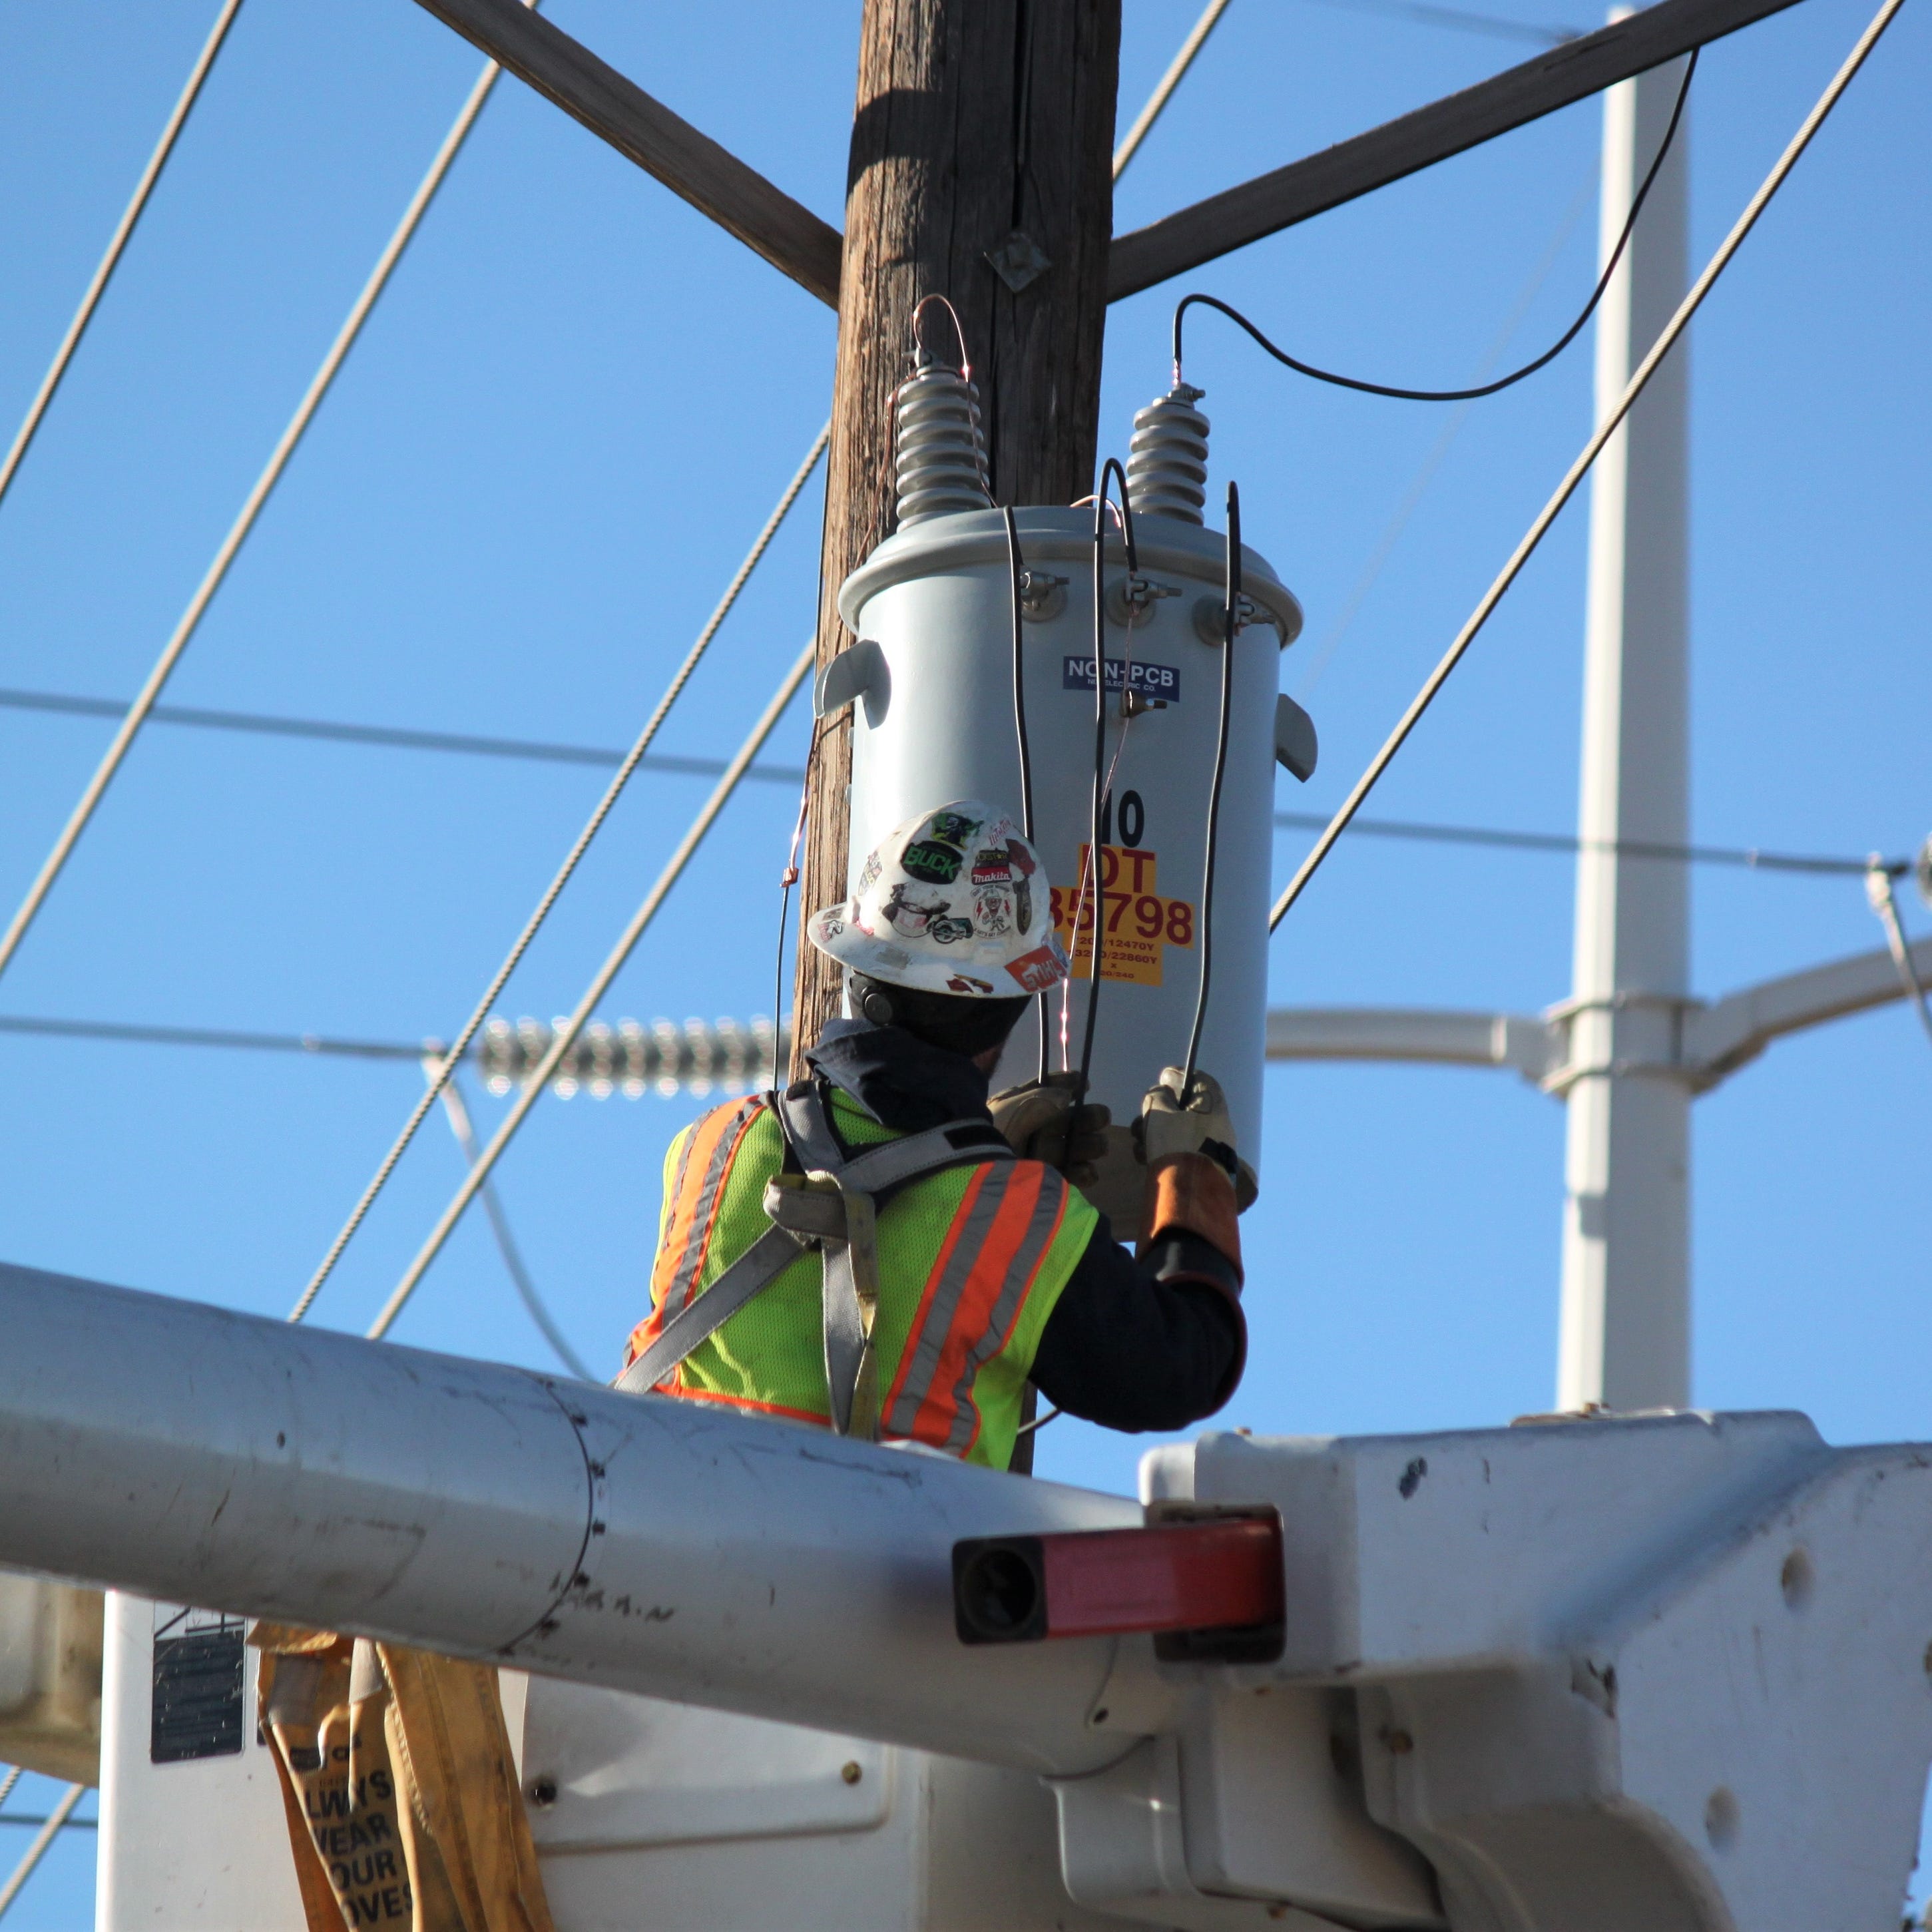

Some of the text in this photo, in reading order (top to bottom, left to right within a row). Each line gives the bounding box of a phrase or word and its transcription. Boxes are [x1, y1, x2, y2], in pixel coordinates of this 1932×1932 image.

[1069, 660, 1174, 687] NON-PCB
[1104, 679, 1140, 689] ELECRIC
[903, 845, 961, 879] BUCK
[1082, 844, 1155, 893] DT
[972, 871, 1011, 883] makita
[1072, 937, 1155, 951] 20/12470Y
[1068, 949, 1157, 965] 320/22860Y
[1021, 959, 1066, 989] STIHL
